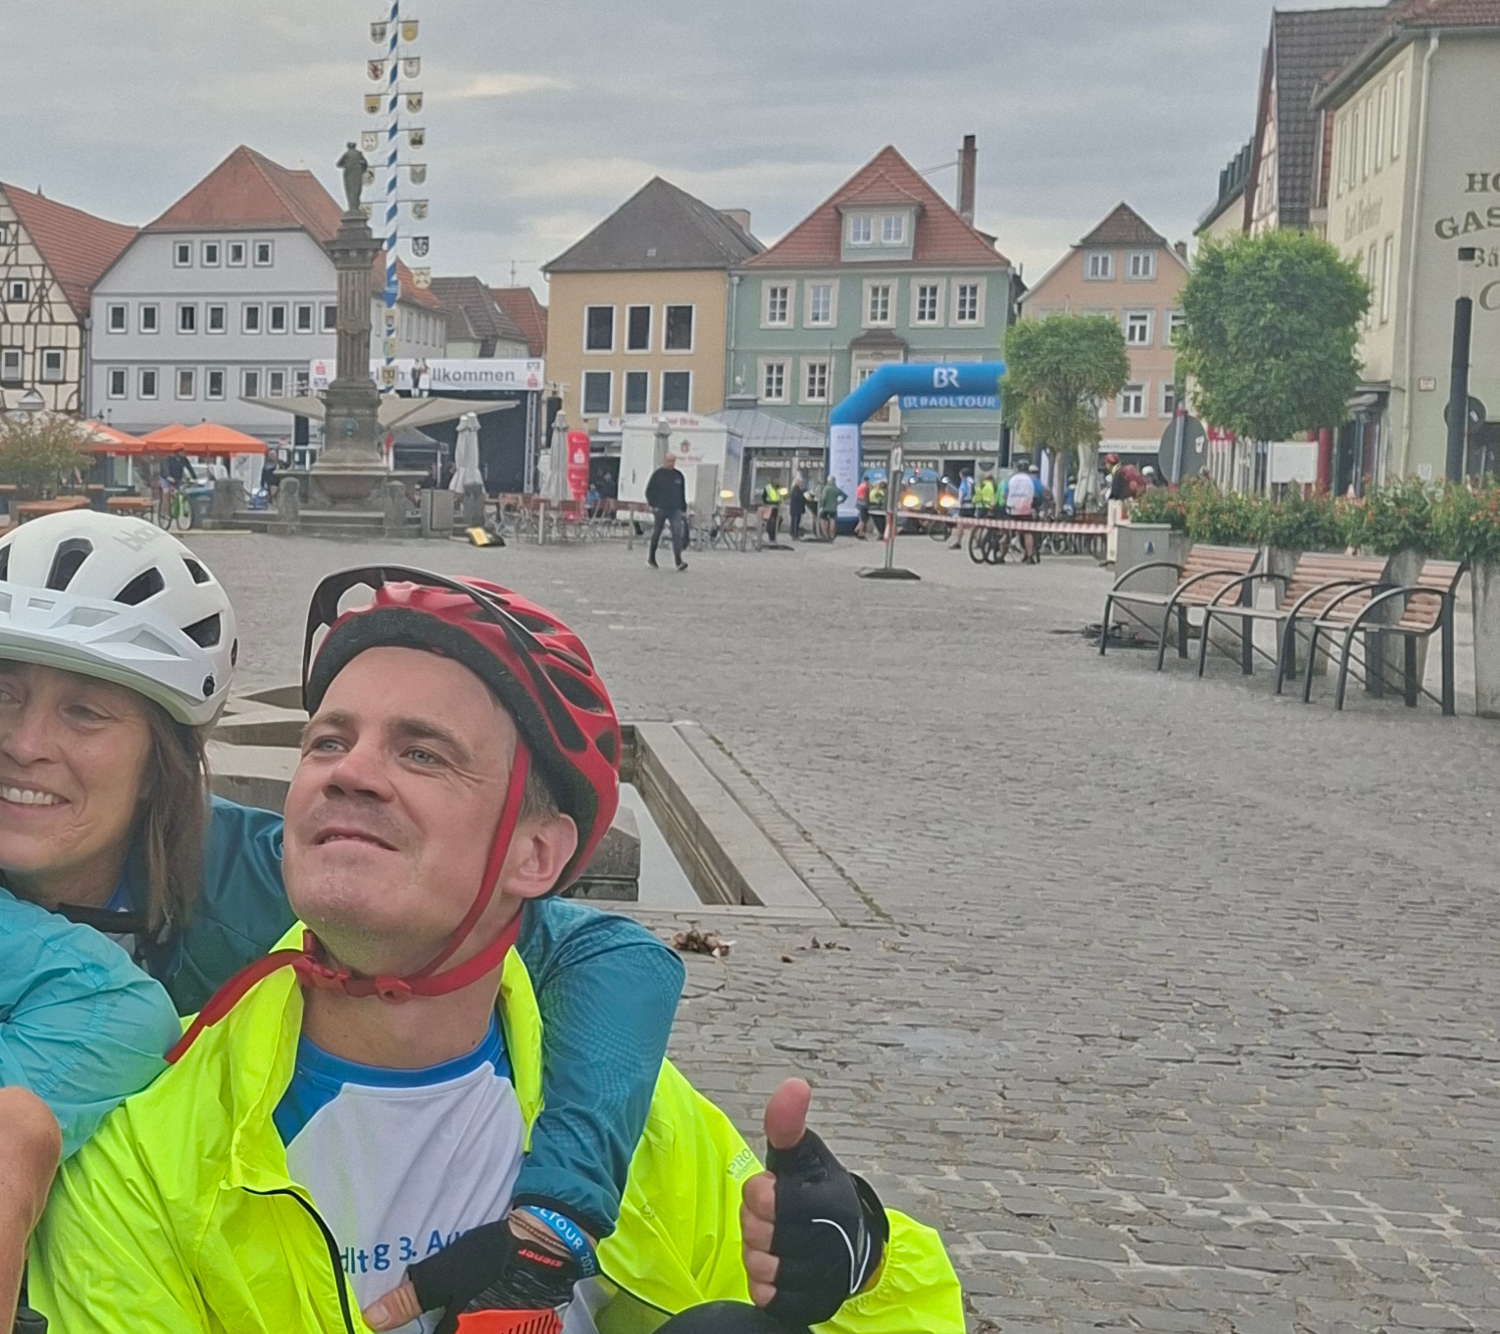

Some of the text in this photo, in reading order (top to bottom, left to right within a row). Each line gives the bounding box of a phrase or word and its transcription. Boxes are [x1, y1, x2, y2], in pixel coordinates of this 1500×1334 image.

[432, 366, 516, 383] llkommen
[933, 367, 960, 388] BR
[920, 396, 996, 408] RADLTOUR
[529, 1205, 583, 1250] LTOUR
